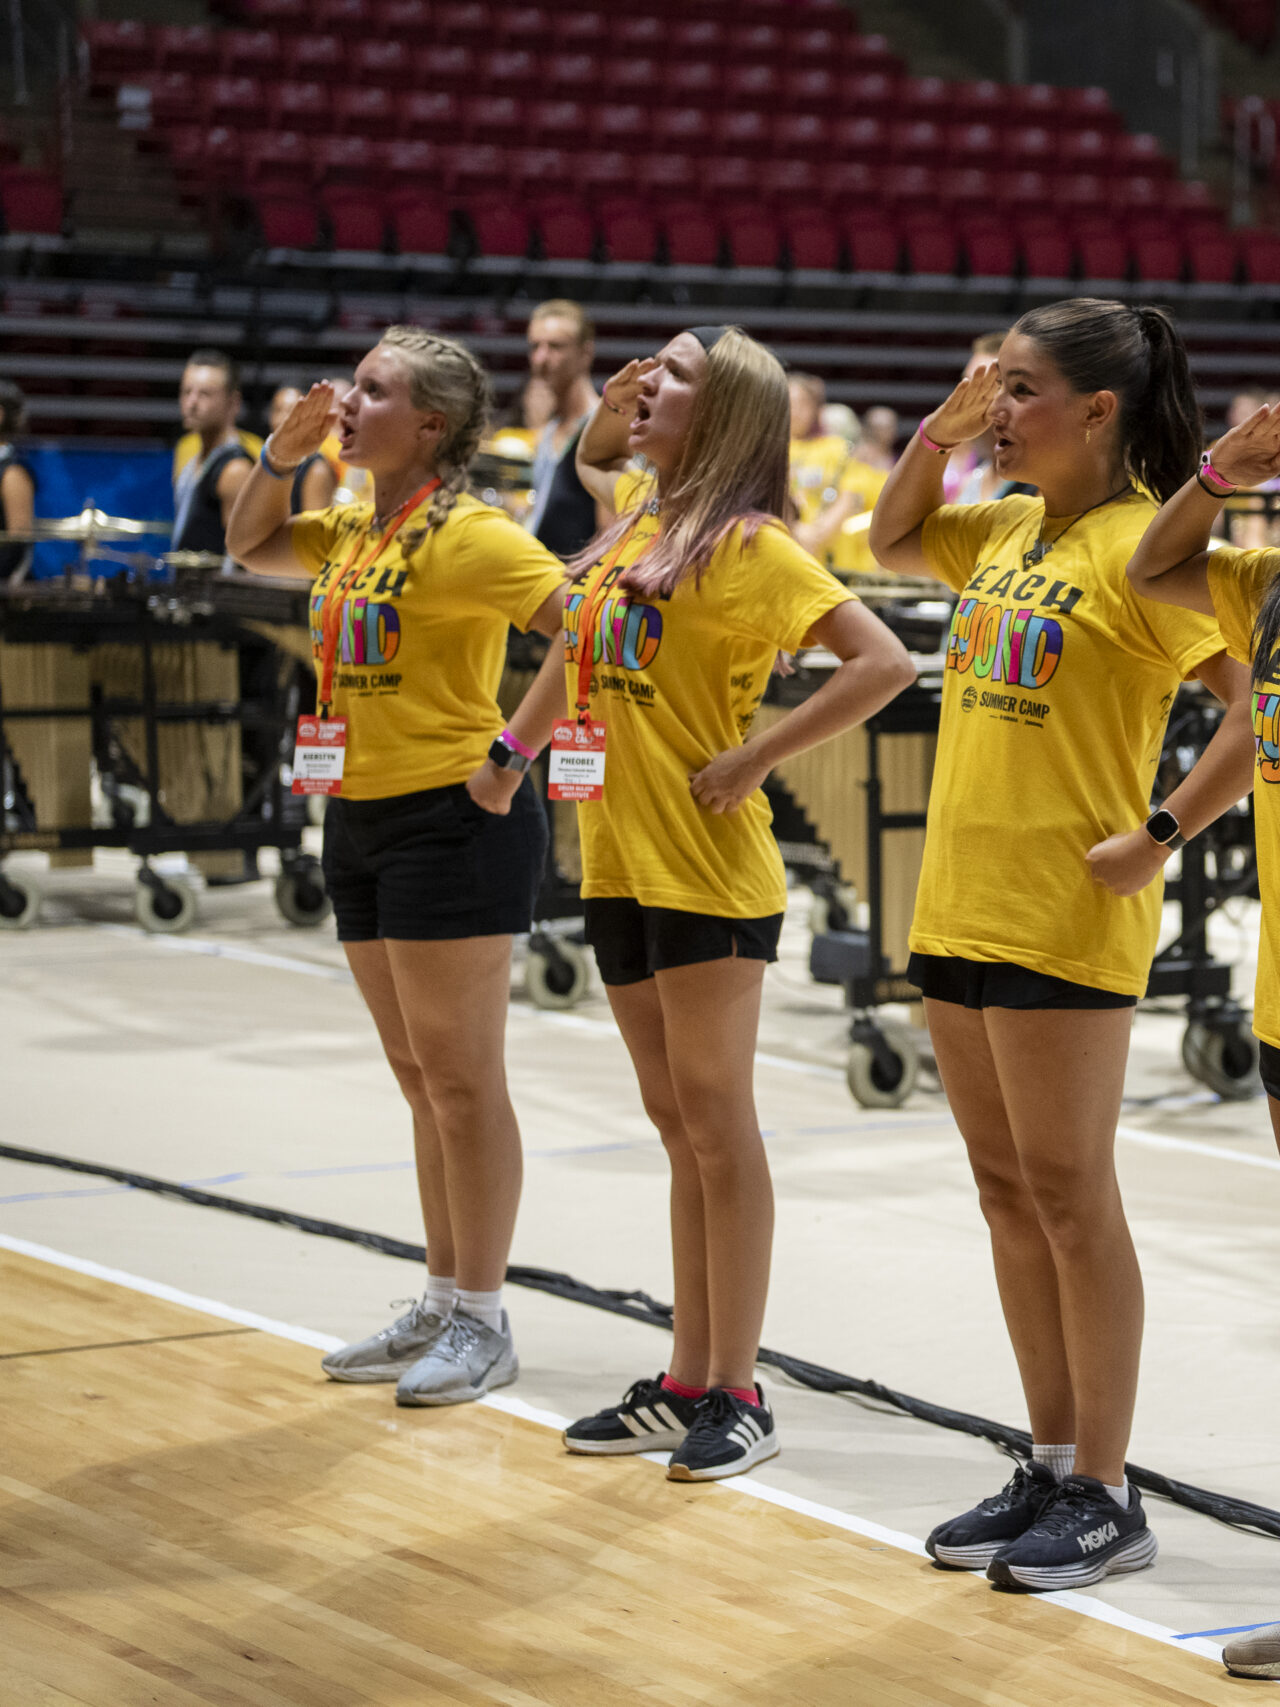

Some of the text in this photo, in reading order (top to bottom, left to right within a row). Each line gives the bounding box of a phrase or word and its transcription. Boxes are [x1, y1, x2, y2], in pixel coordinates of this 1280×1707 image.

[965, 562, 1085, 616] EACH
[980, 691, 1017, 713] SUMMER
[1019, 698, 1050, 720] CAMP
[1077, 1520, 1119, 1554] HOKA
